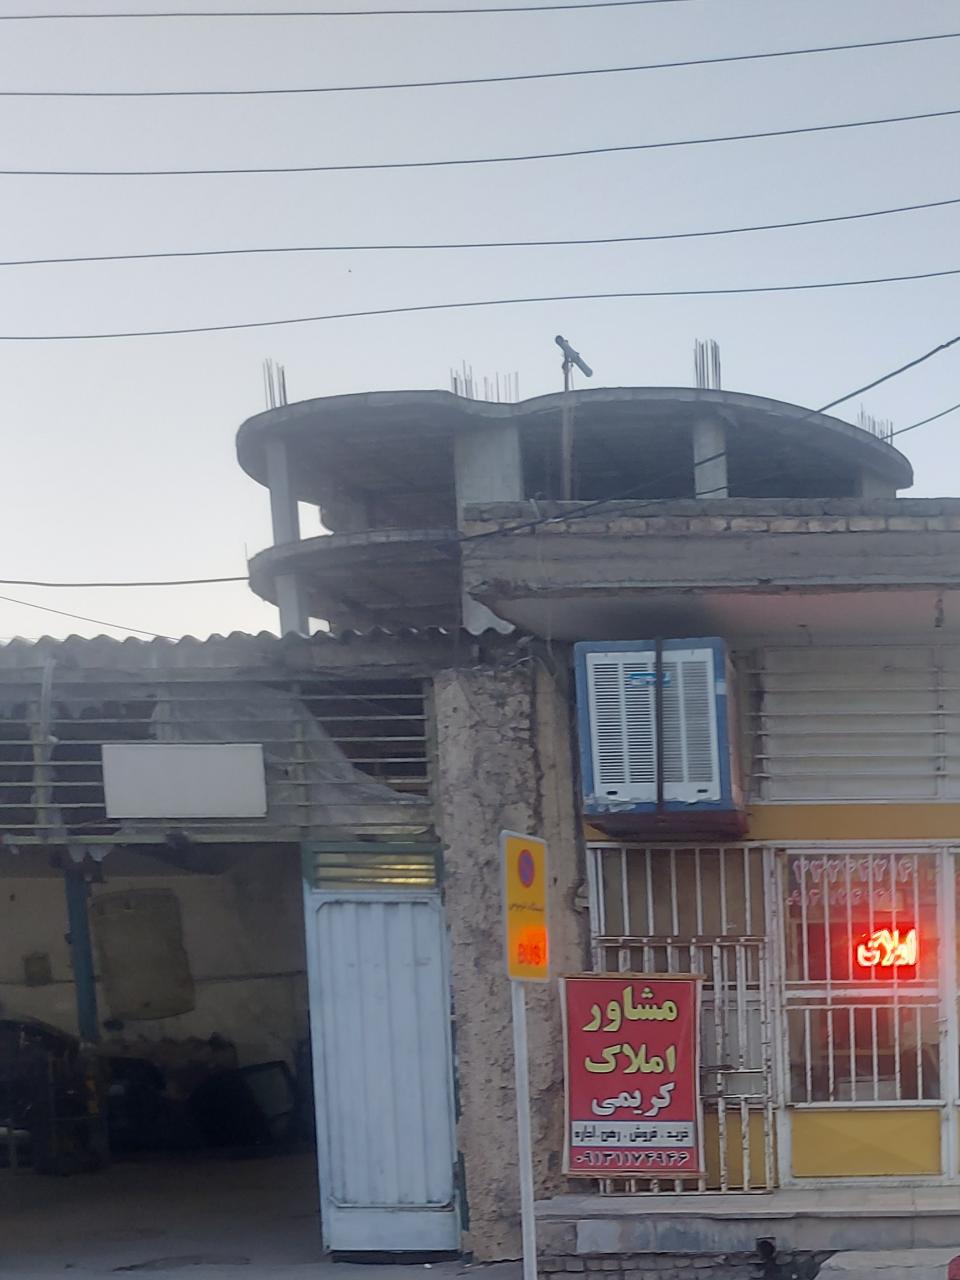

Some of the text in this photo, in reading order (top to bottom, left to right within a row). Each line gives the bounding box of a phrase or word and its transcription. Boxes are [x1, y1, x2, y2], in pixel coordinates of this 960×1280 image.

[582, 985, 678, 1032] مشاور
[584, 1043, 677, 1074] املاک
[591, 1082, 676, 1117] کریمی
